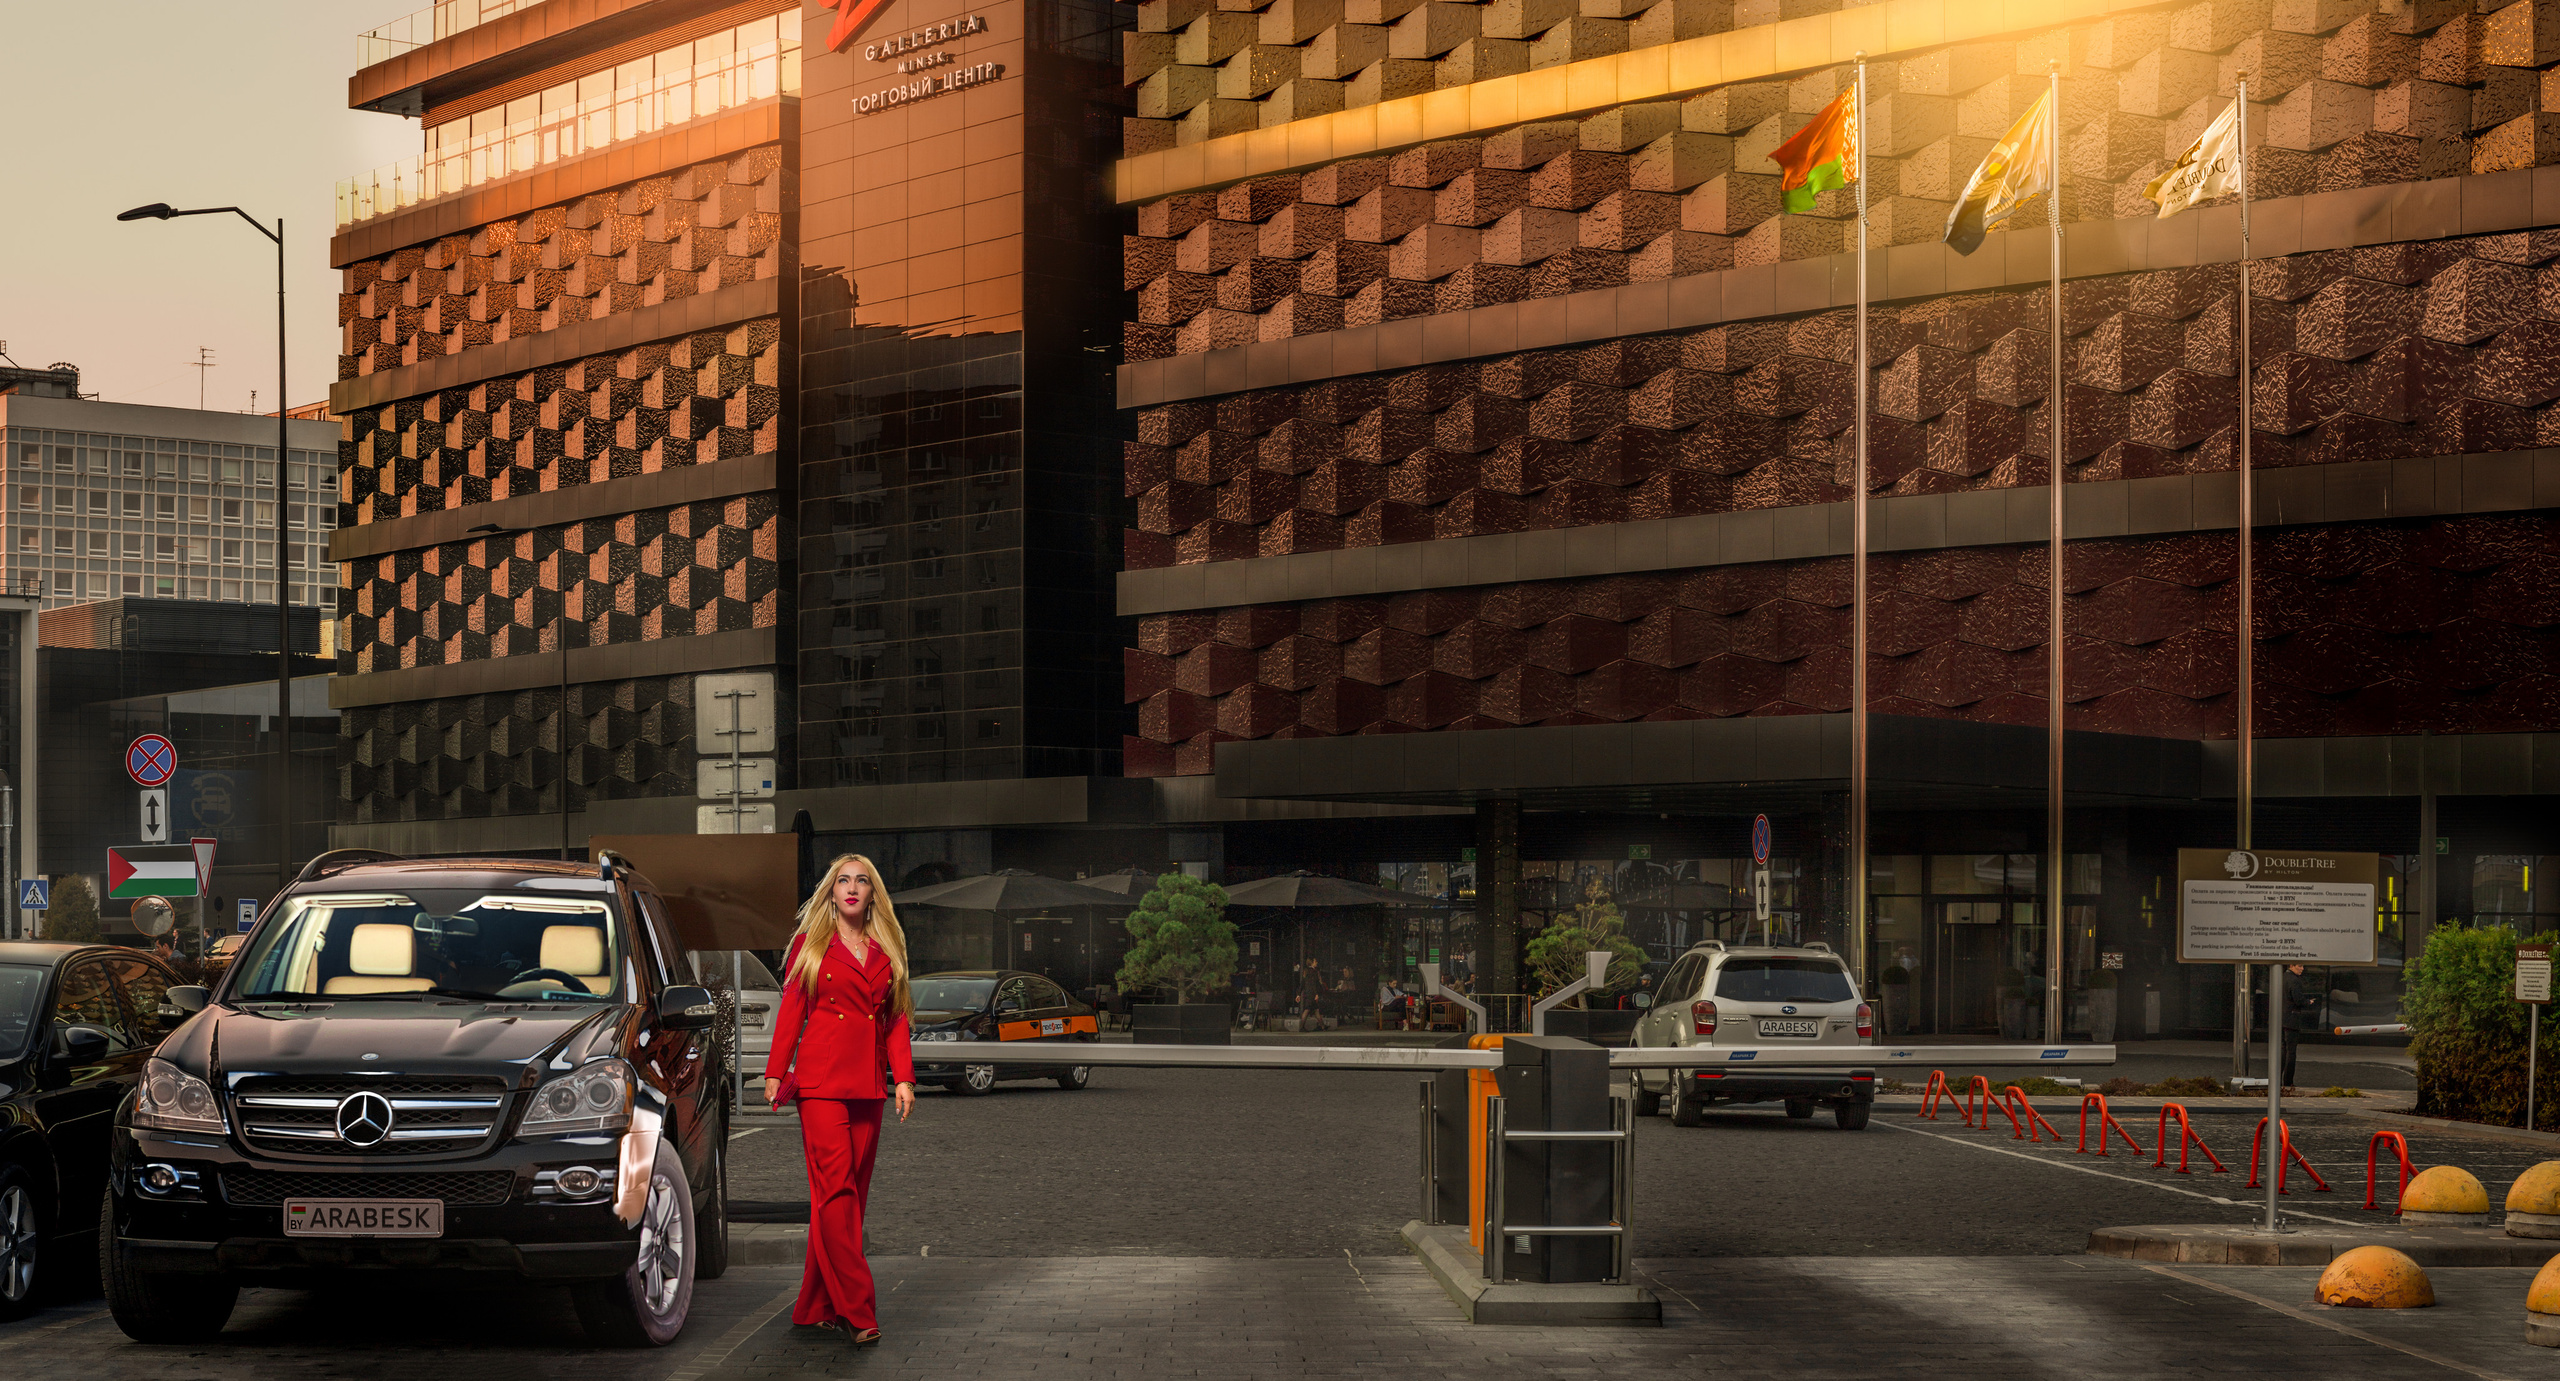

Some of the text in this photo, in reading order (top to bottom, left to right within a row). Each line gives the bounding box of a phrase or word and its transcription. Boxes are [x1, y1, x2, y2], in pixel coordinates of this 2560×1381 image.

[865, 14, 980, 61] GALLERIA
[897, 51, 945, 74] MINSK
[851, 62, 995, 114] ТОРГОВЫЙ ЦЕНТР
[1763, 1022, 1814, 1032] ARABESK
[290, 1220, 303, 1229] BY
[310, 1208, 430, 1228] ARABESK
